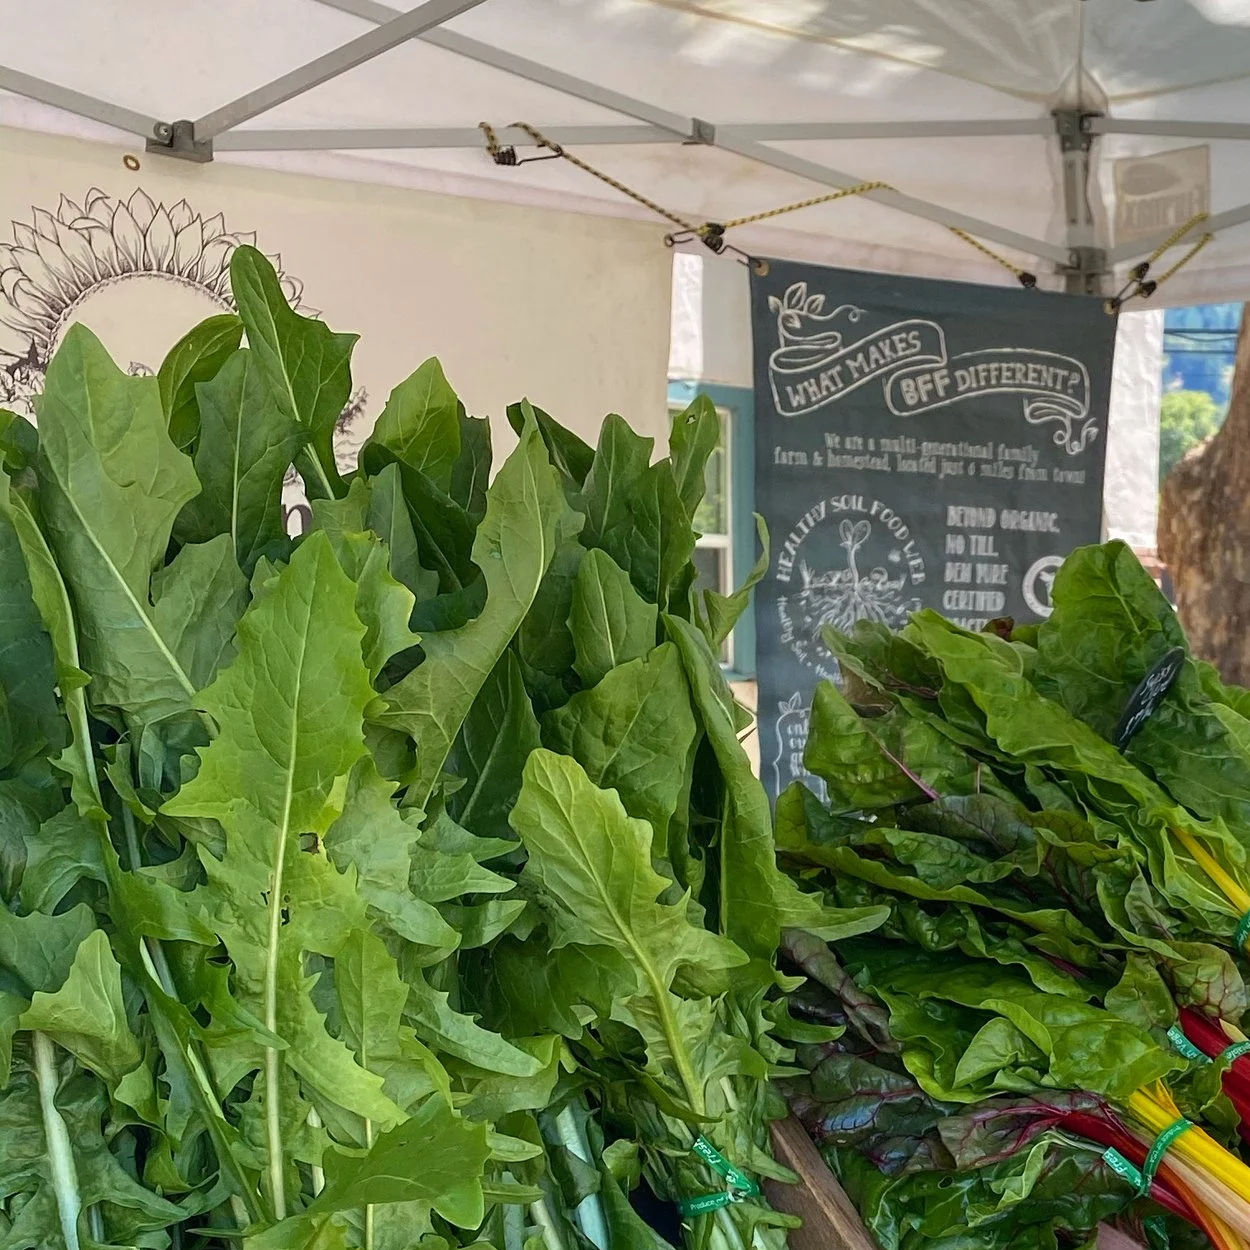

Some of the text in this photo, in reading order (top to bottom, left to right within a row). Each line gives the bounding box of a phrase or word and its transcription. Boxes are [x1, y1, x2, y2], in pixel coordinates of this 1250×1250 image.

[785, 330, 921, 408] WHAT MAKES
[900, 362, 1081, 406] BFF DIFFERENT?
[774, 446, 808, 465] farm
[812, 451, 823, 466] &
[1018, 463, 1048, 481] from
[824, 432, 840, 449] We
[844, 436, 863, 450] are
[867, 438, 876, 450] a
[998, 443, 1040, 468] family
[946, 505, 996, 528] BEYOND
[776, 494, 926, 585] HEALTHY SOIL FOOD WEB
[945, 533, 965, 555] NO
[942, 590, 1005, 612] CERTIFIED
